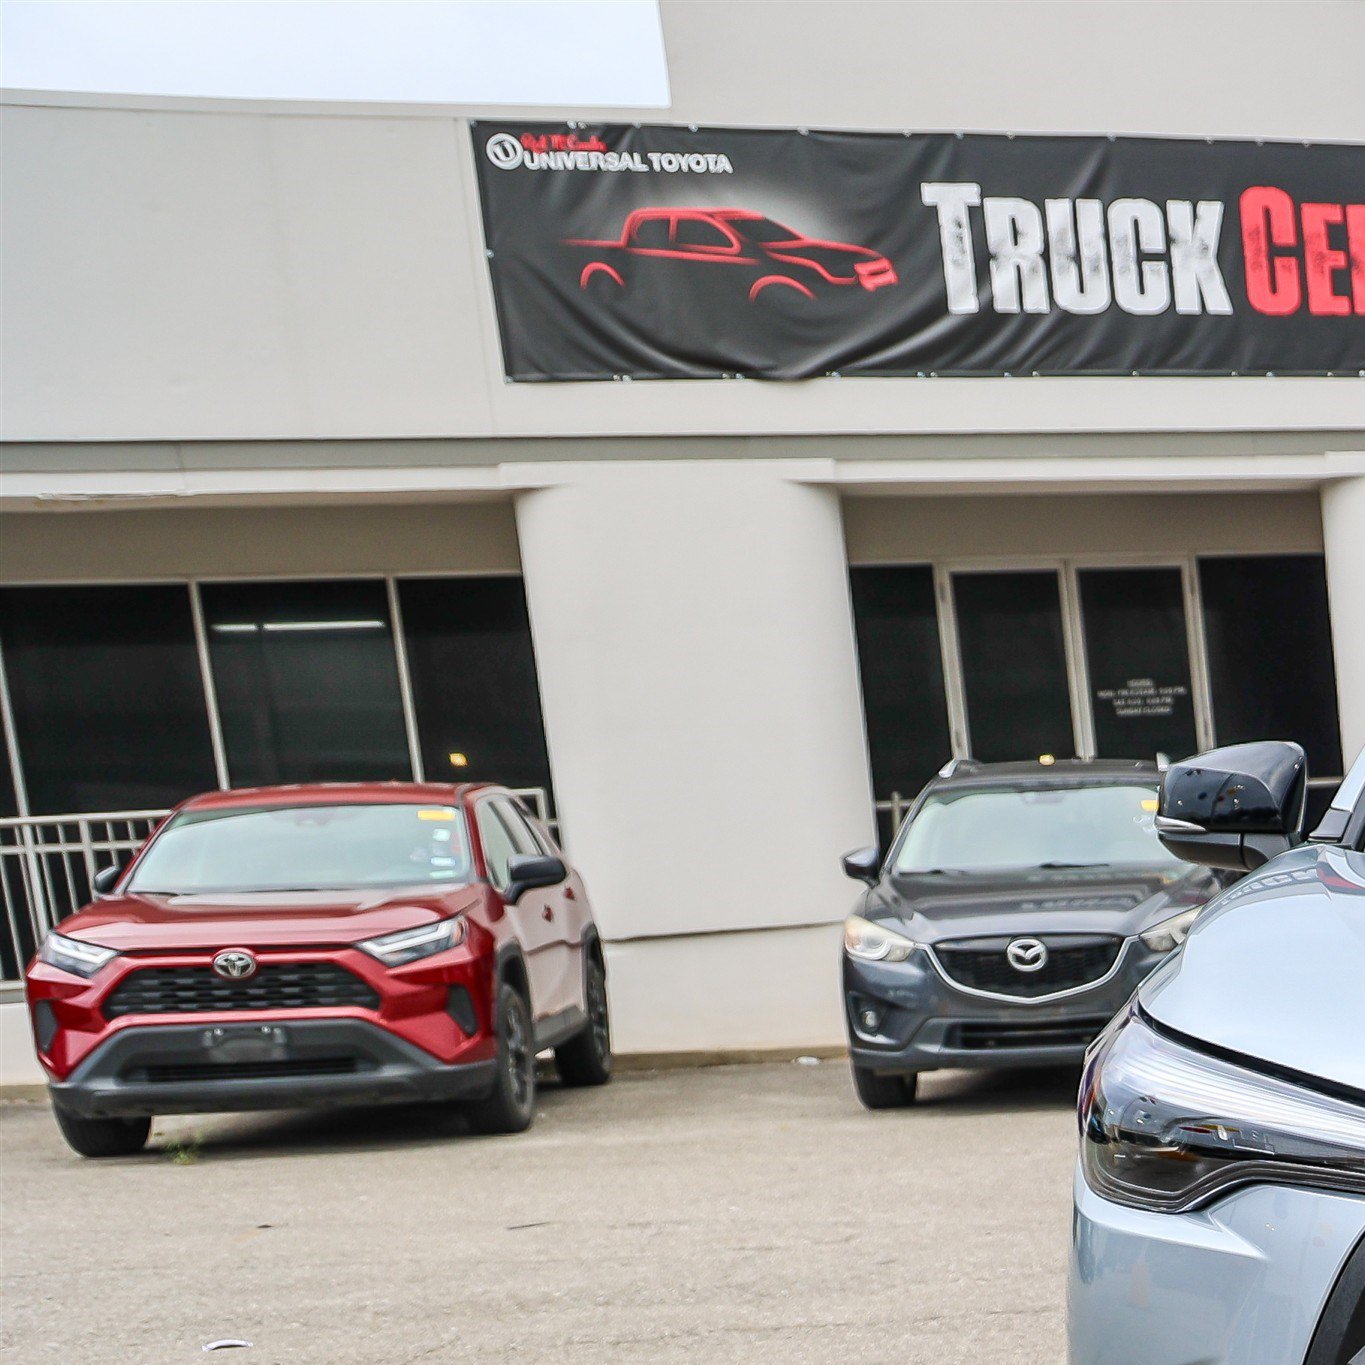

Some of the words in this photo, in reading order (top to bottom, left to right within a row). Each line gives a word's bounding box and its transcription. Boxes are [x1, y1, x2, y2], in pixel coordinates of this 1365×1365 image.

[523, 151, 649, 171] UNIVERSAL
[648, 152, 734, 174] TOYOTA
[920, 182, 1234, 316] TRUCK
